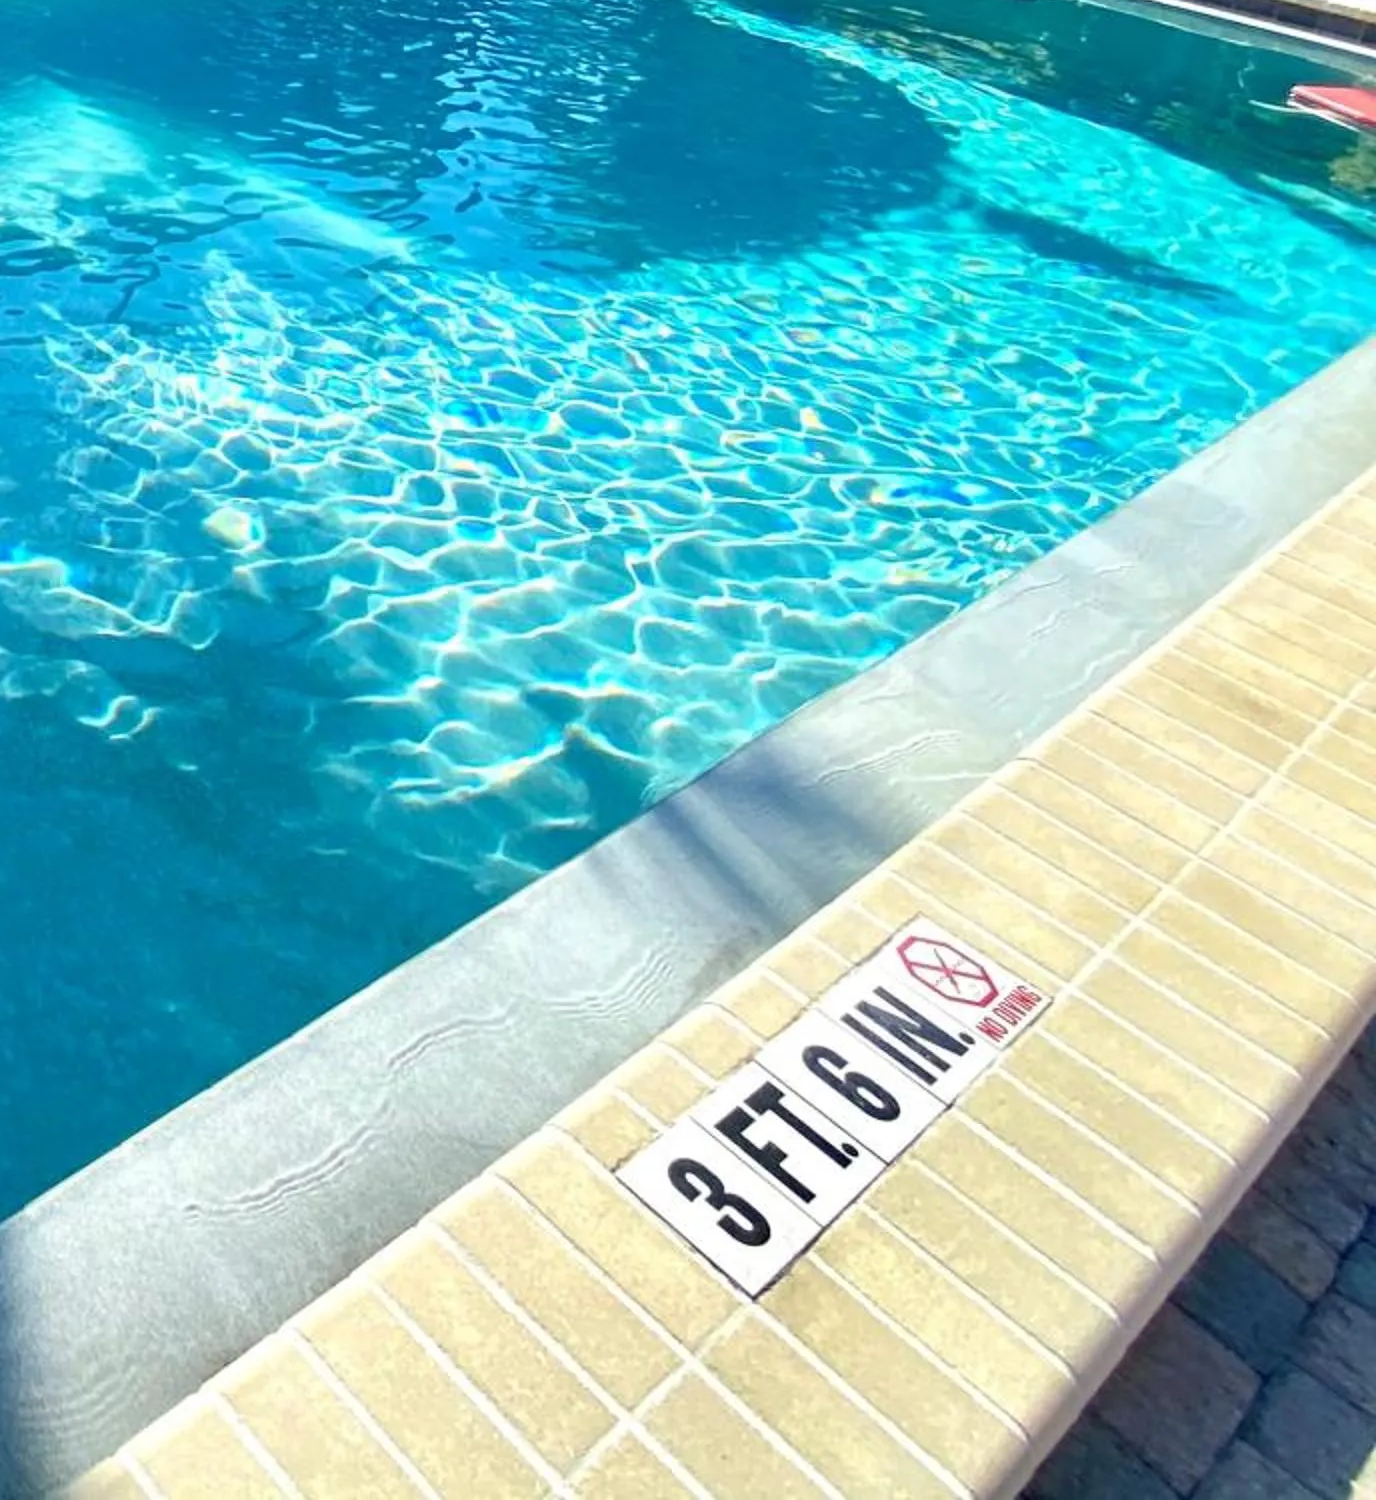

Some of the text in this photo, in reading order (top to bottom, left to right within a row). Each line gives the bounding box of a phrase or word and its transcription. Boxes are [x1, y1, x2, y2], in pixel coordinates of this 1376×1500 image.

[975, 985, 1043, 1043] NO DIVING
[667, 985, 976, 1247] 3 FT. 6 IN.
